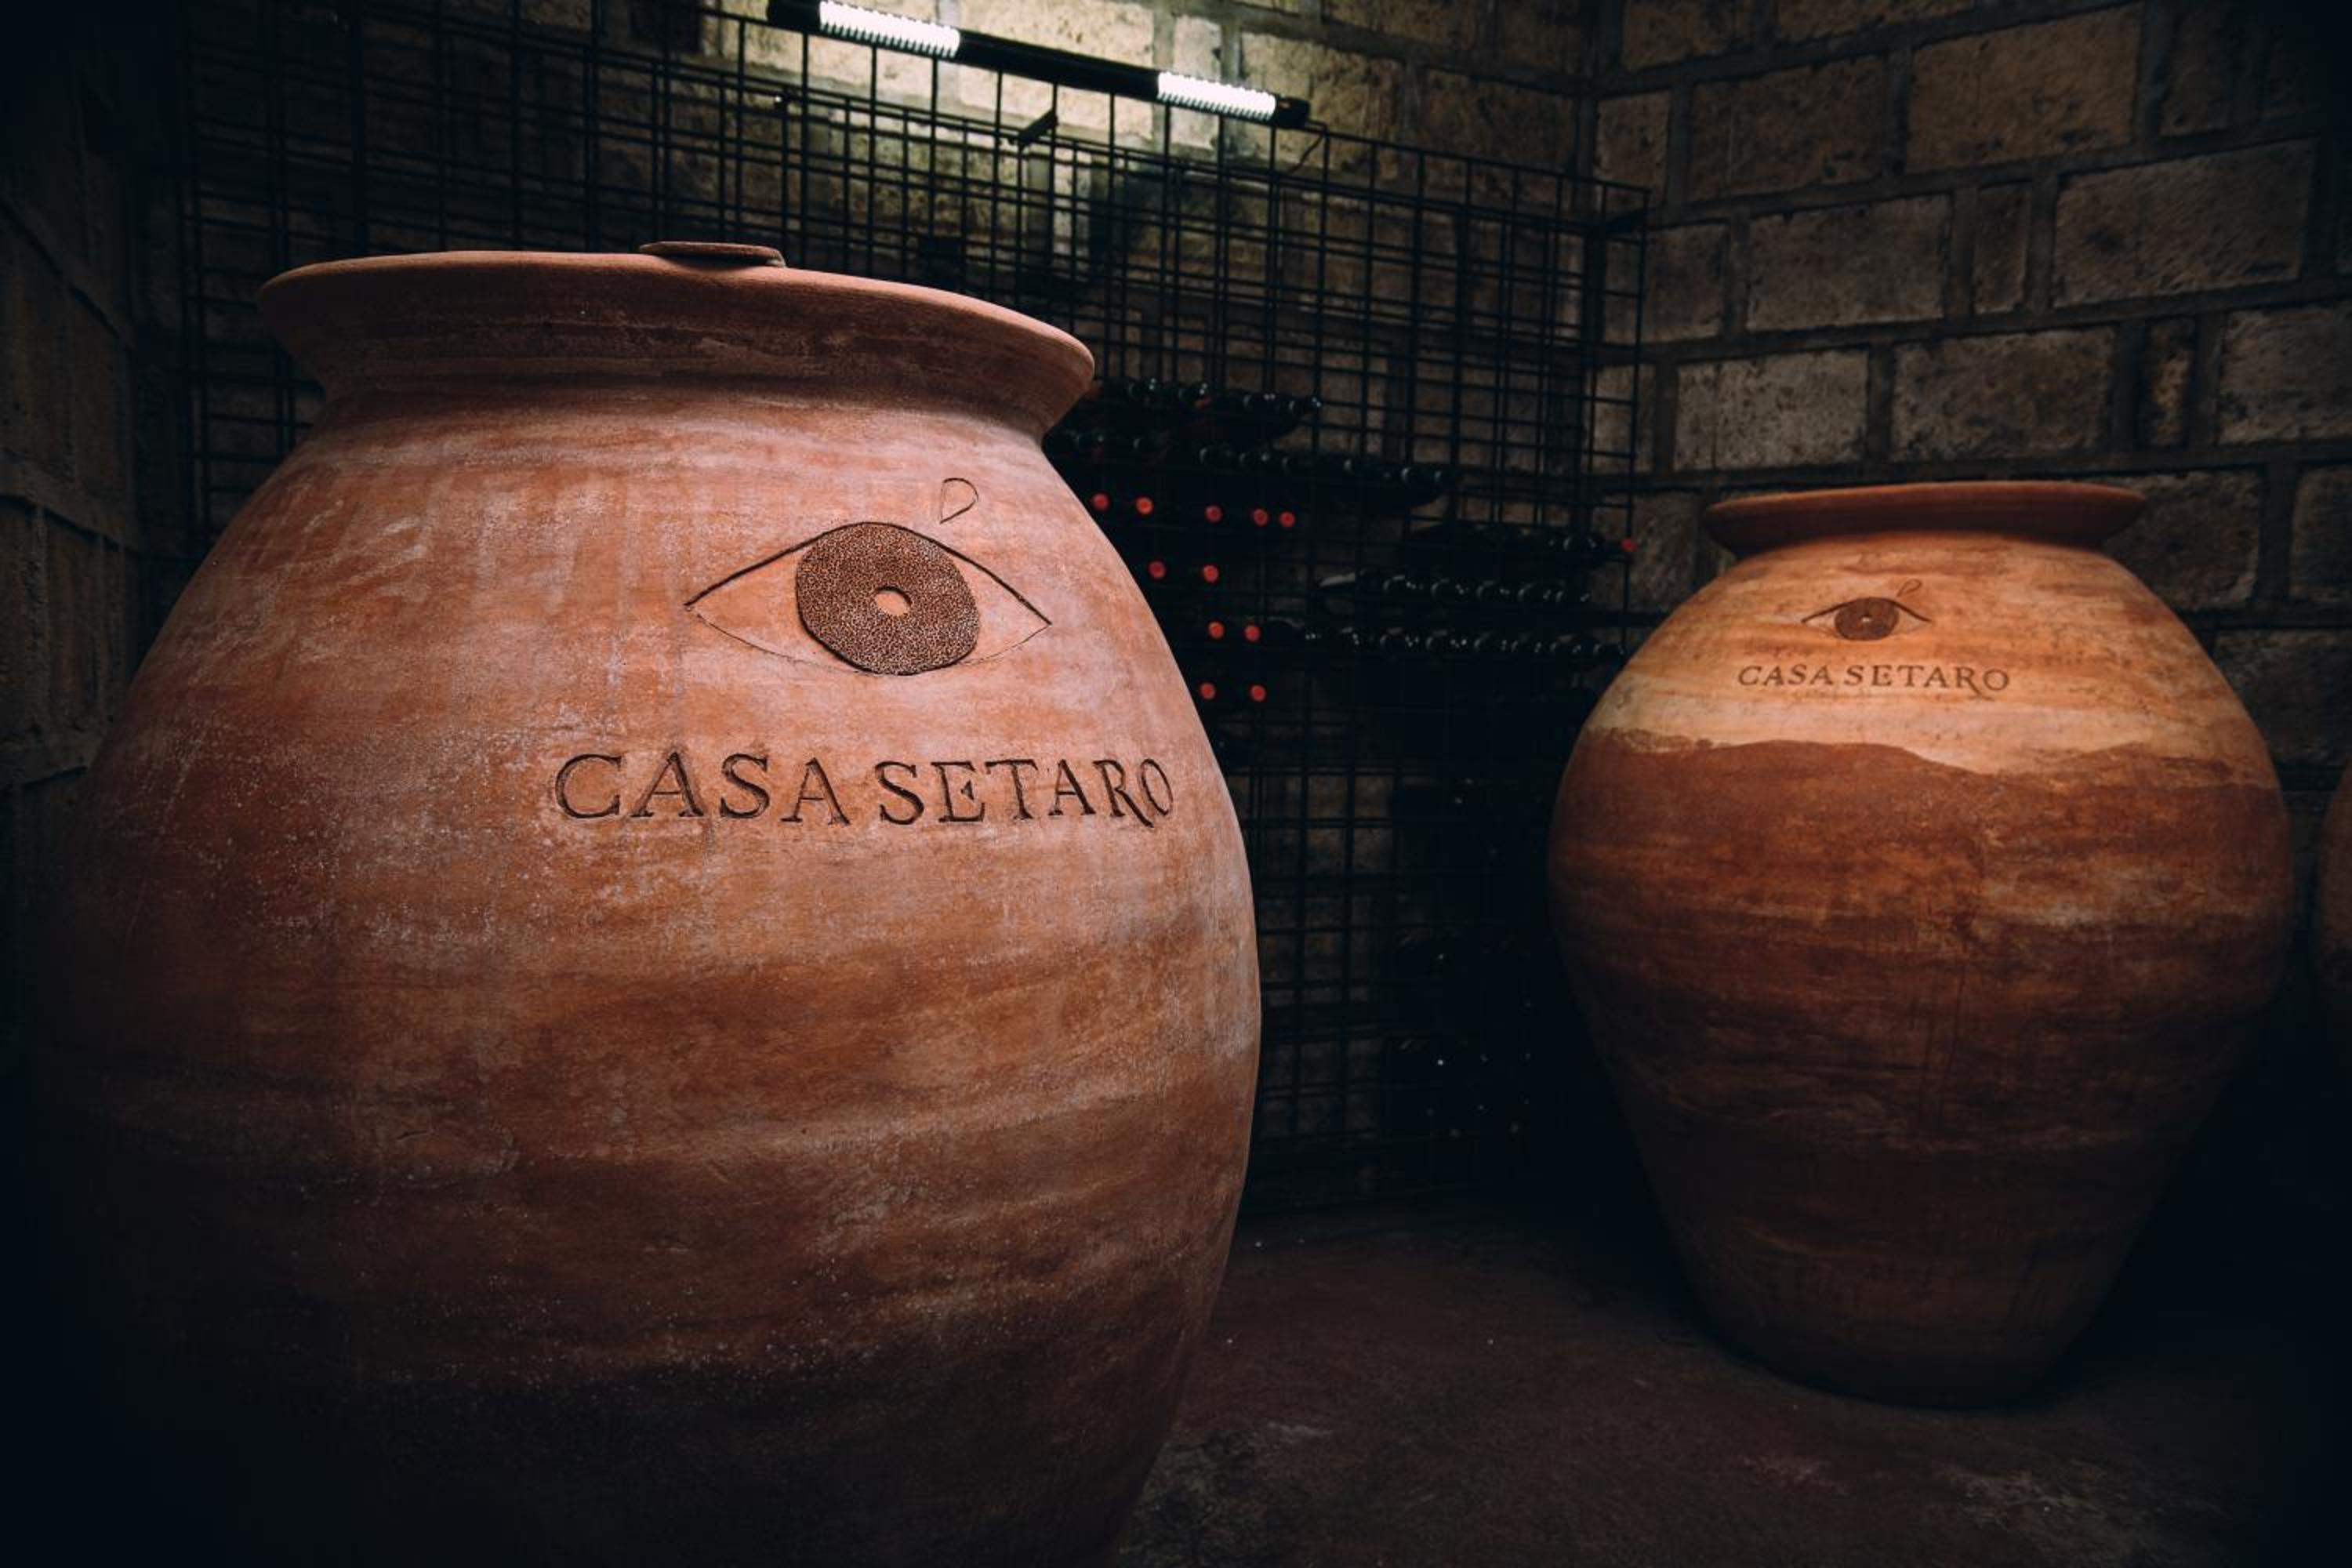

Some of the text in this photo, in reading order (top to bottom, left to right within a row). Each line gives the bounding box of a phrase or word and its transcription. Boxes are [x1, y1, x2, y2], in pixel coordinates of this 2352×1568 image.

[1737, 664, 2010, 701] CASA SETARO
[554, 750, 1173, 828] CASA SETARO
